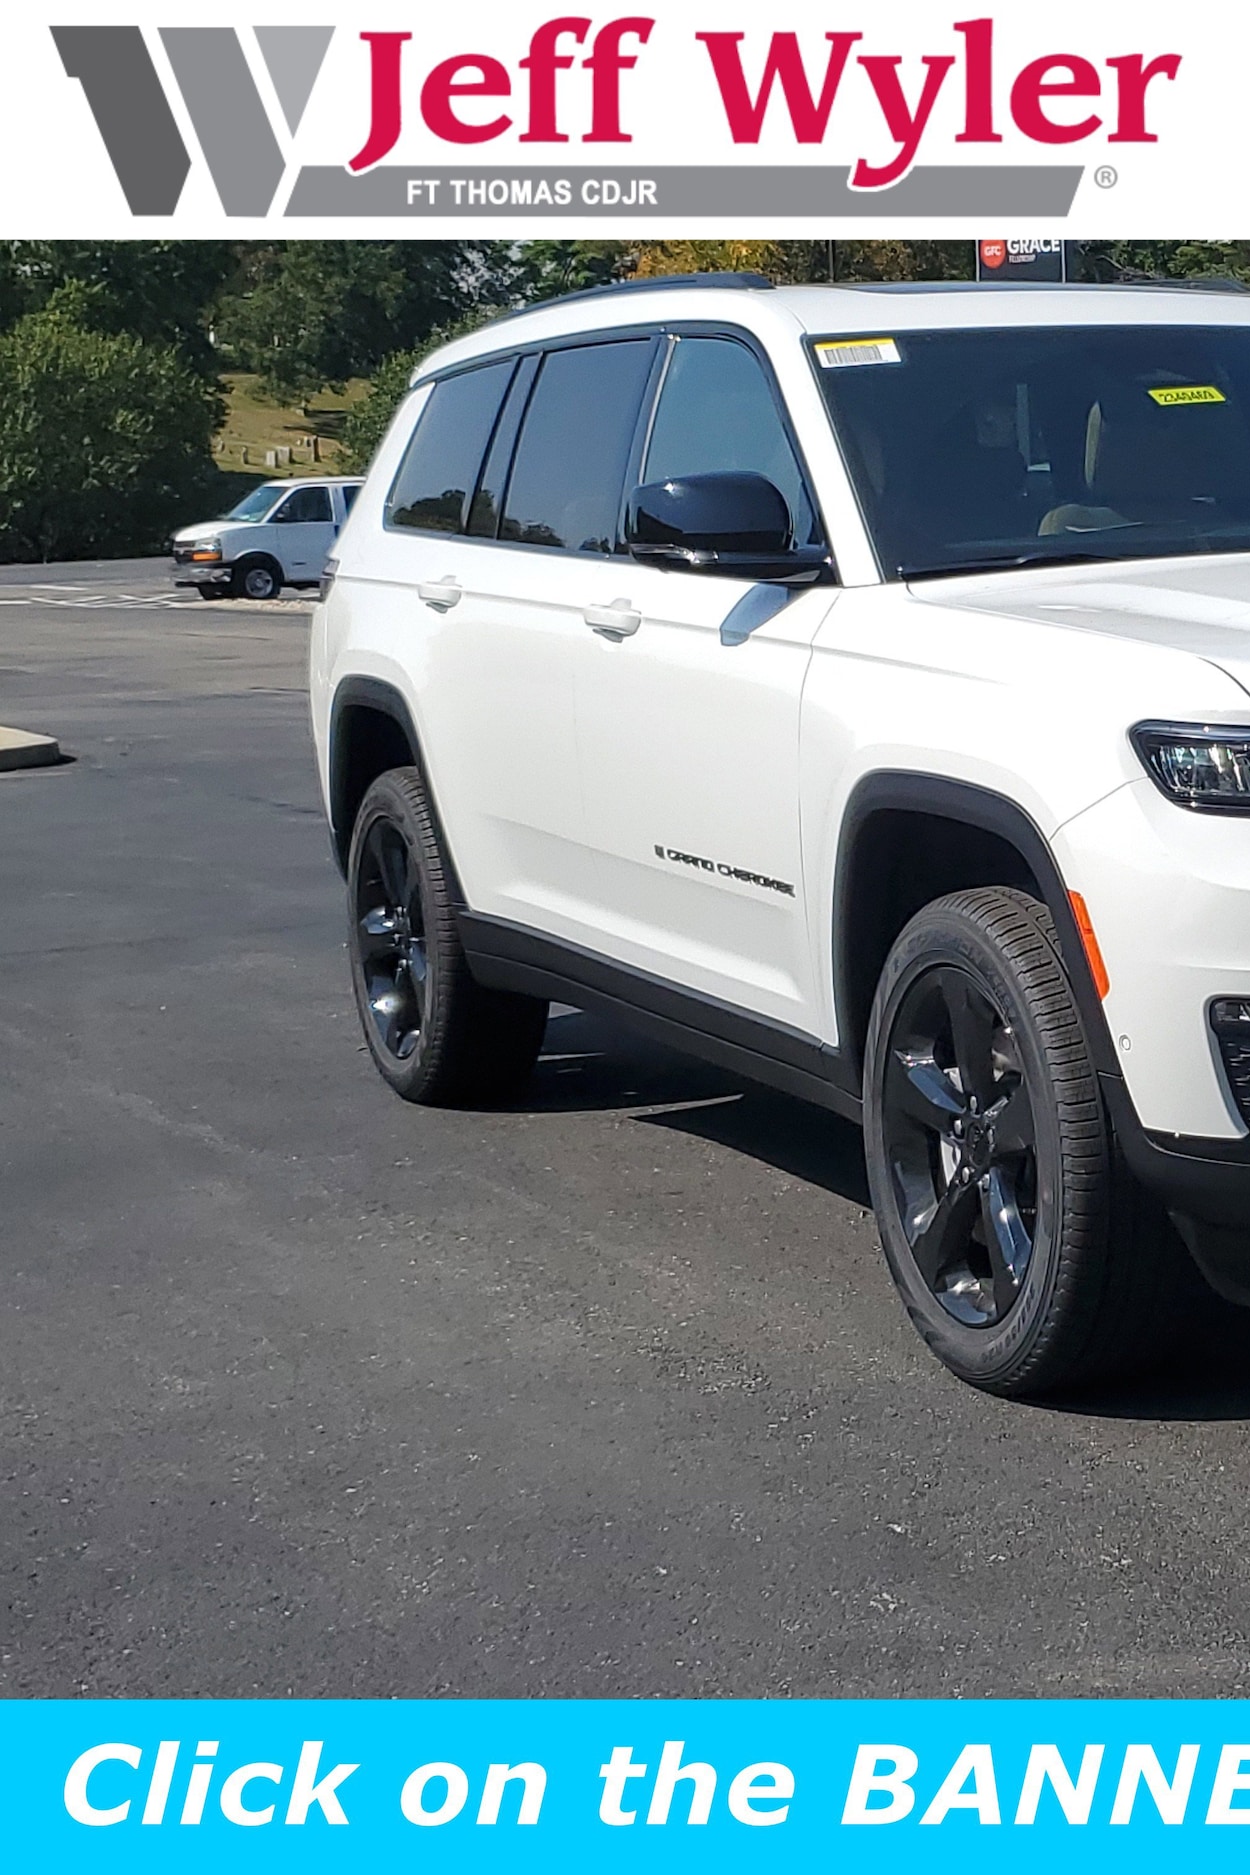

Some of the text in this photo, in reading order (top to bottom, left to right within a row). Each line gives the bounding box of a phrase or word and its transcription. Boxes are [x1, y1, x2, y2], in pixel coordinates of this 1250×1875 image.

[984, 246, 1002, 257] GFC
[1007, 240, 1061, 254] GRACE
[667, 849, 796, 898] GRAND CHEROKEE
